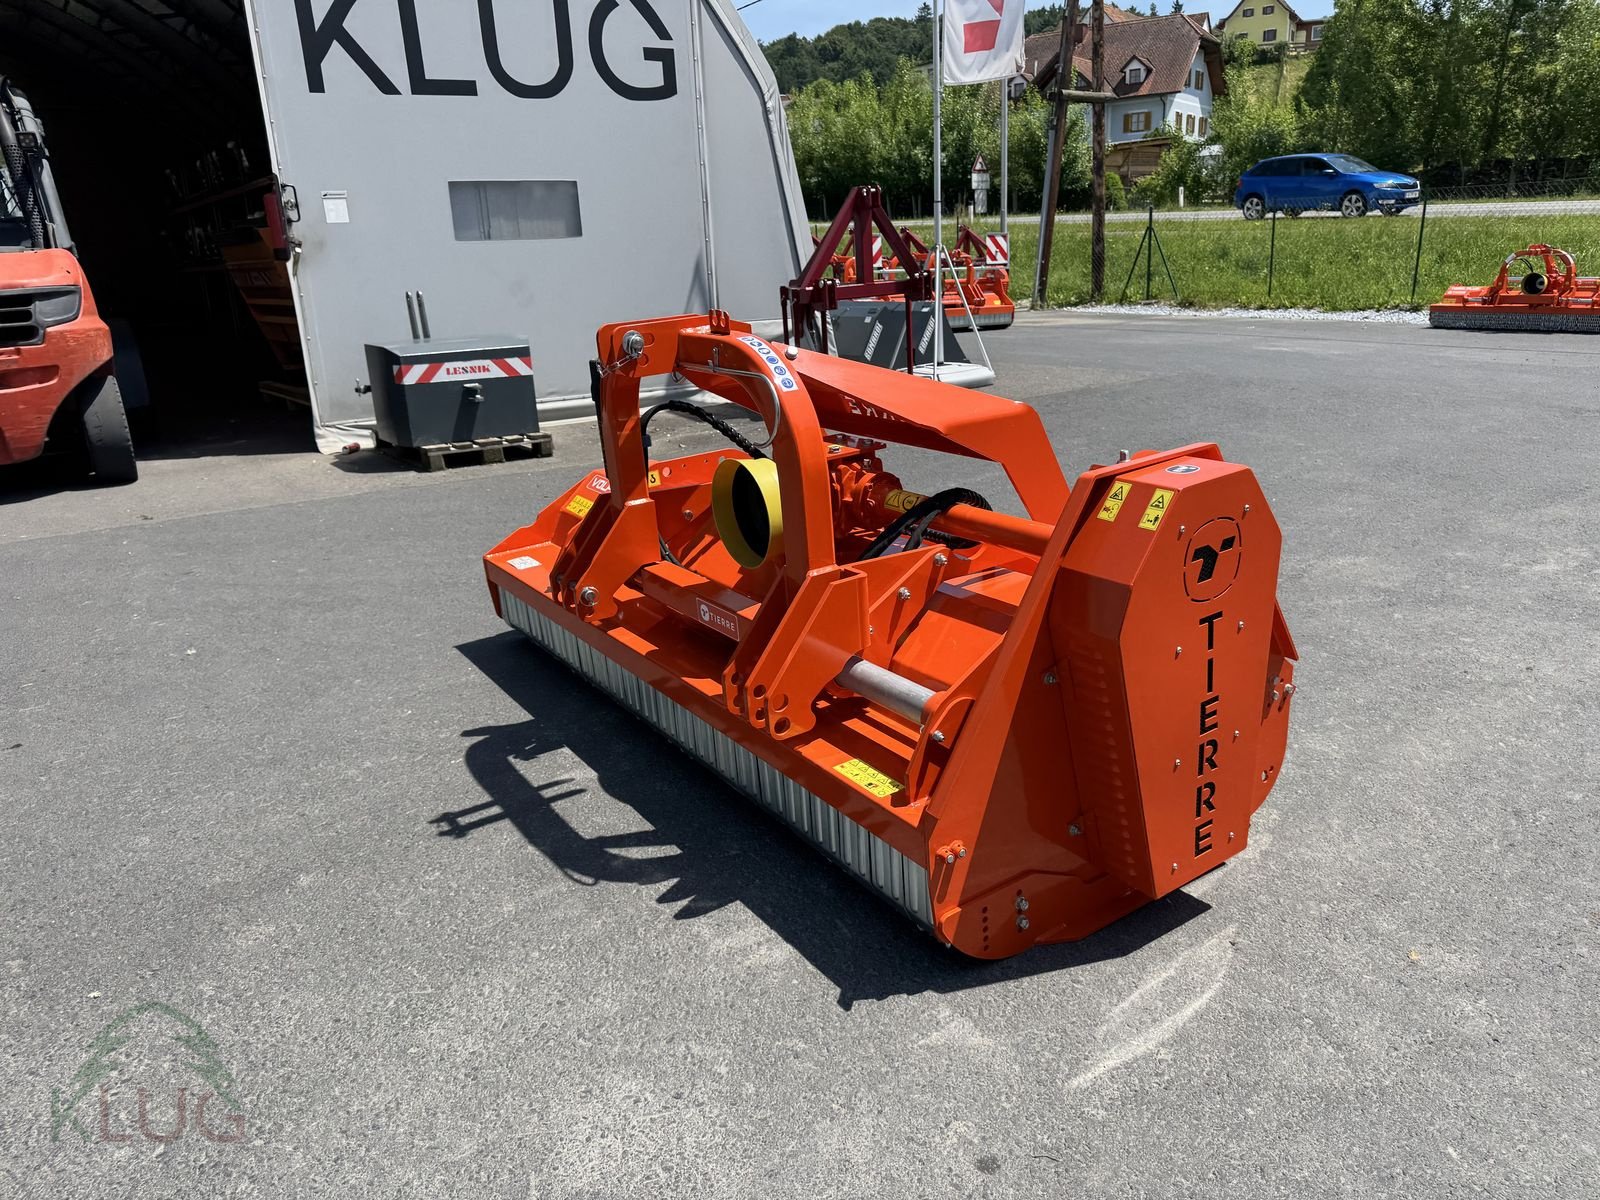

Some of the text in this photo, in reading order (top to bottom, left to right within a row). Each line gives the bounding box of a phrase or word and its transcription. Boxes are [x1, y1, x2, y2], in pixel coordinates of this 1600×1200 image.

[295, 0, 678, 101] KLUG
[446, 364, 491, 376] LESNIK
[710, 612, 736, 632] TIERRE
[1194, 610, 1224, 859] TIERRE
